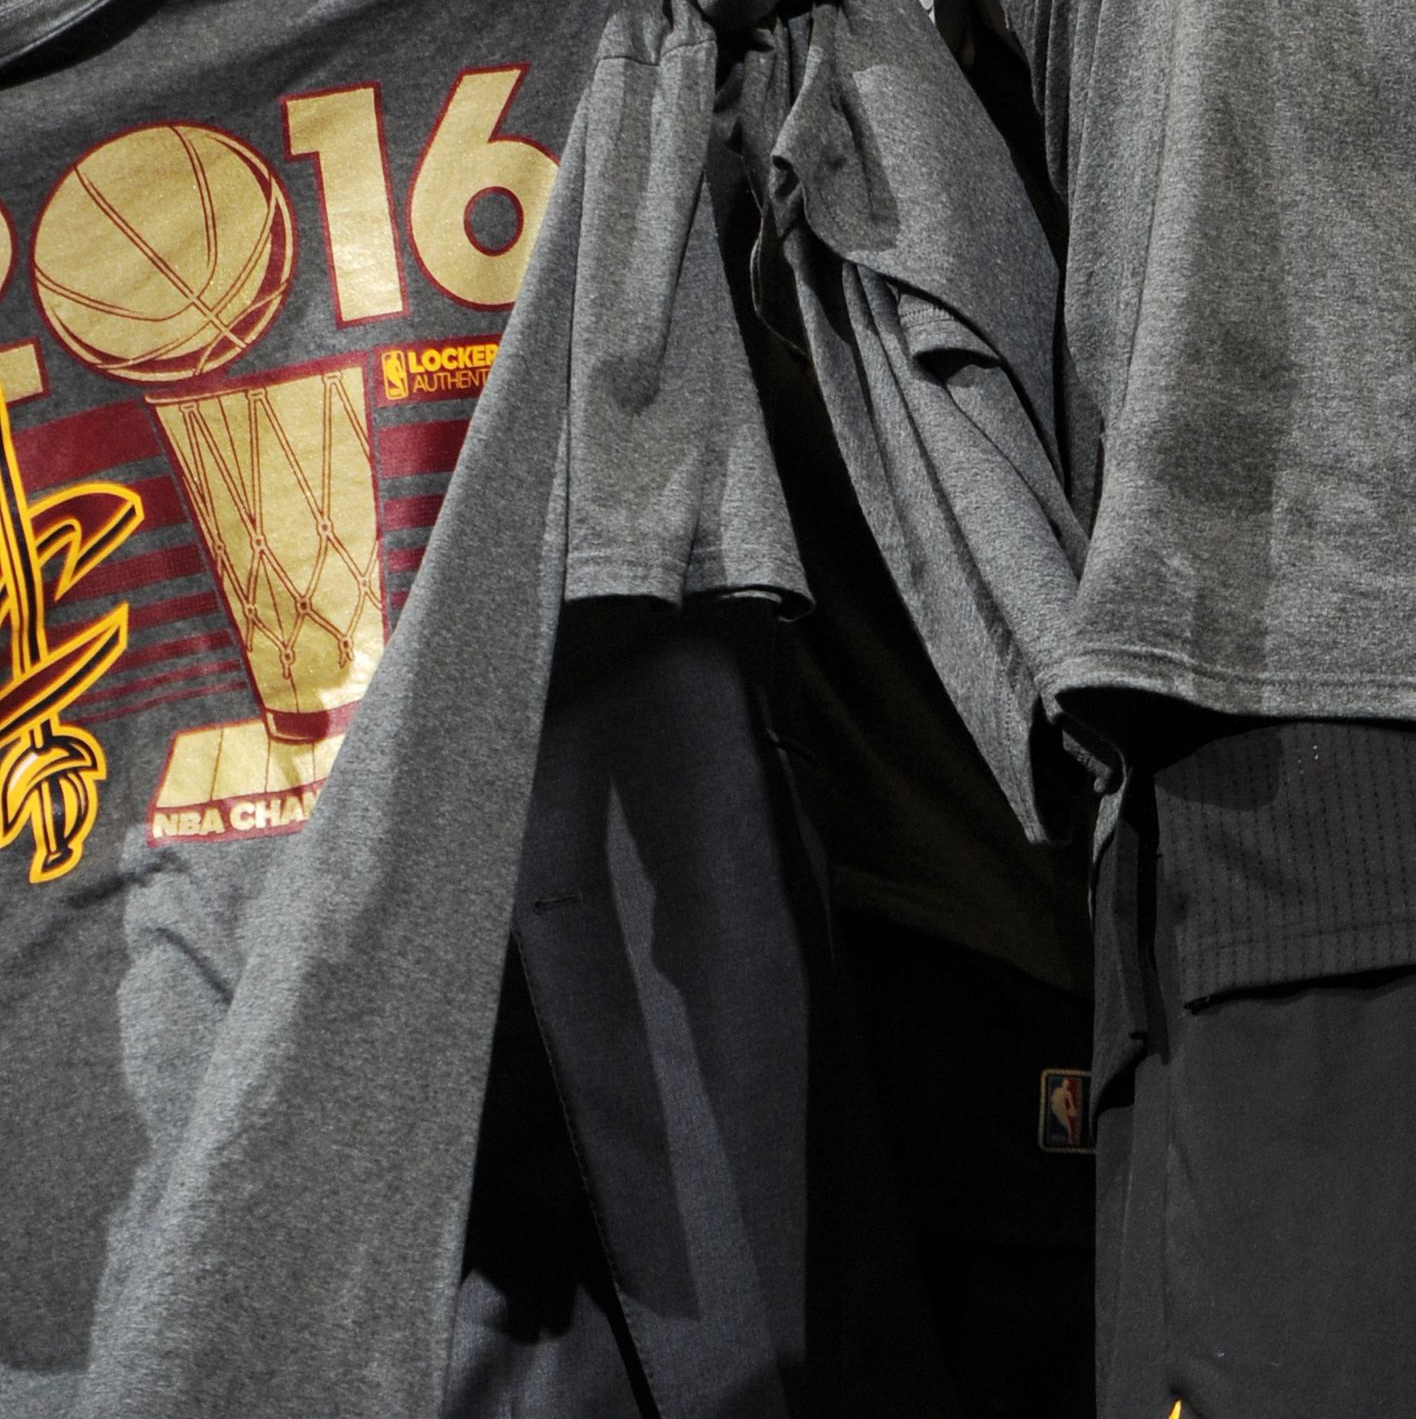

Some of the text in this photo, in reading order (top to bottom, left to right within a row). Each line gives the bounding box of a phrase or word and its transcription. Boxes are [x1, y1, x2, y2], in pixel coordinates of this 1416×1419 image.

[407, 344, 500, 374] LOCKER
[412, 368, 491, 394] AUTHENT
[152, 807, 226, 839] NBA
